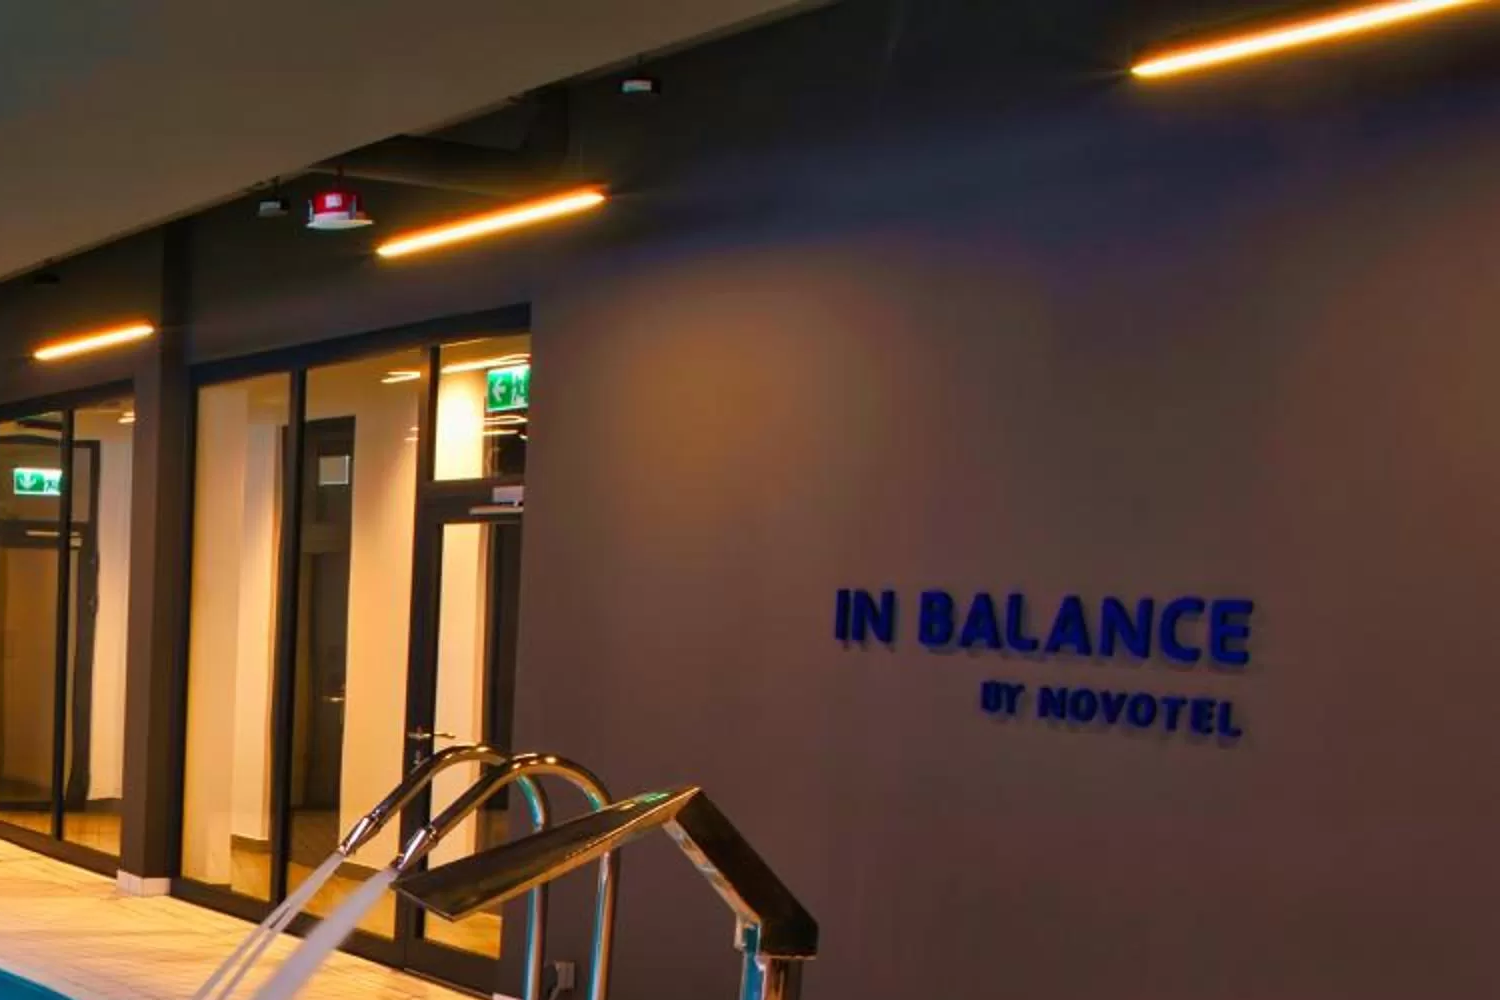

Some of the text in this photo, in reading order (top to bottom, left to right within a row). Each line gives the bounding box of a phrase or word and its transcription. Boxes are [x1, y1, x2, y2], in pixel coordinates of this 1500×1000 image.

[835, 588, 1254, 665] IN BALANCE
[980, 680, 1242, 738] BY NOVOTEL
